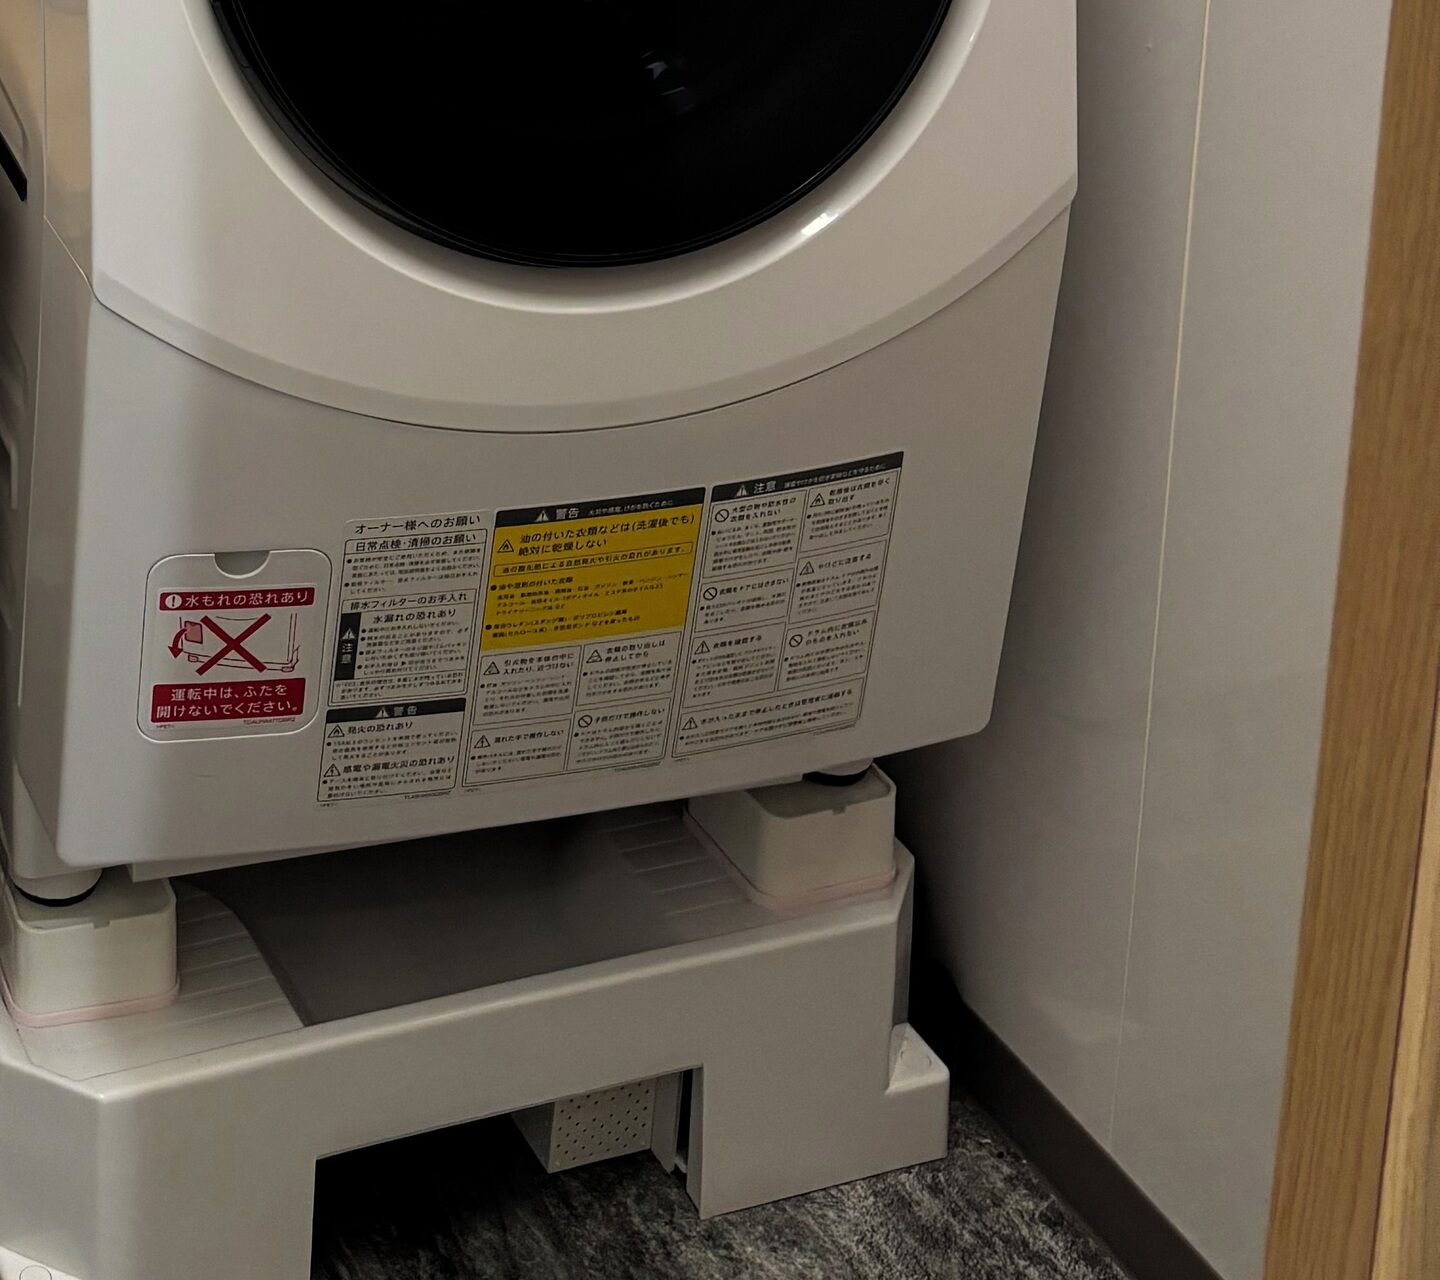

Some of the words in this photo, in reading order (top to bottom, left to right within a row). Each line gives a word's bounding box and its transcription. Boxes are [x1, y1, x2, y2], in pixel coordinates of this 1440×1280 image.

[355, 515, 481, 534] オーナー様へのお願い
[185, 591, 309, 607] 水もれの恐れあり
[350, 593, 467, 611] 排水フィルターのお手入れ
[171, 684, 288, 702] 運転中は、ふたを
[156, 699, 298, 718] 開けないでください。
